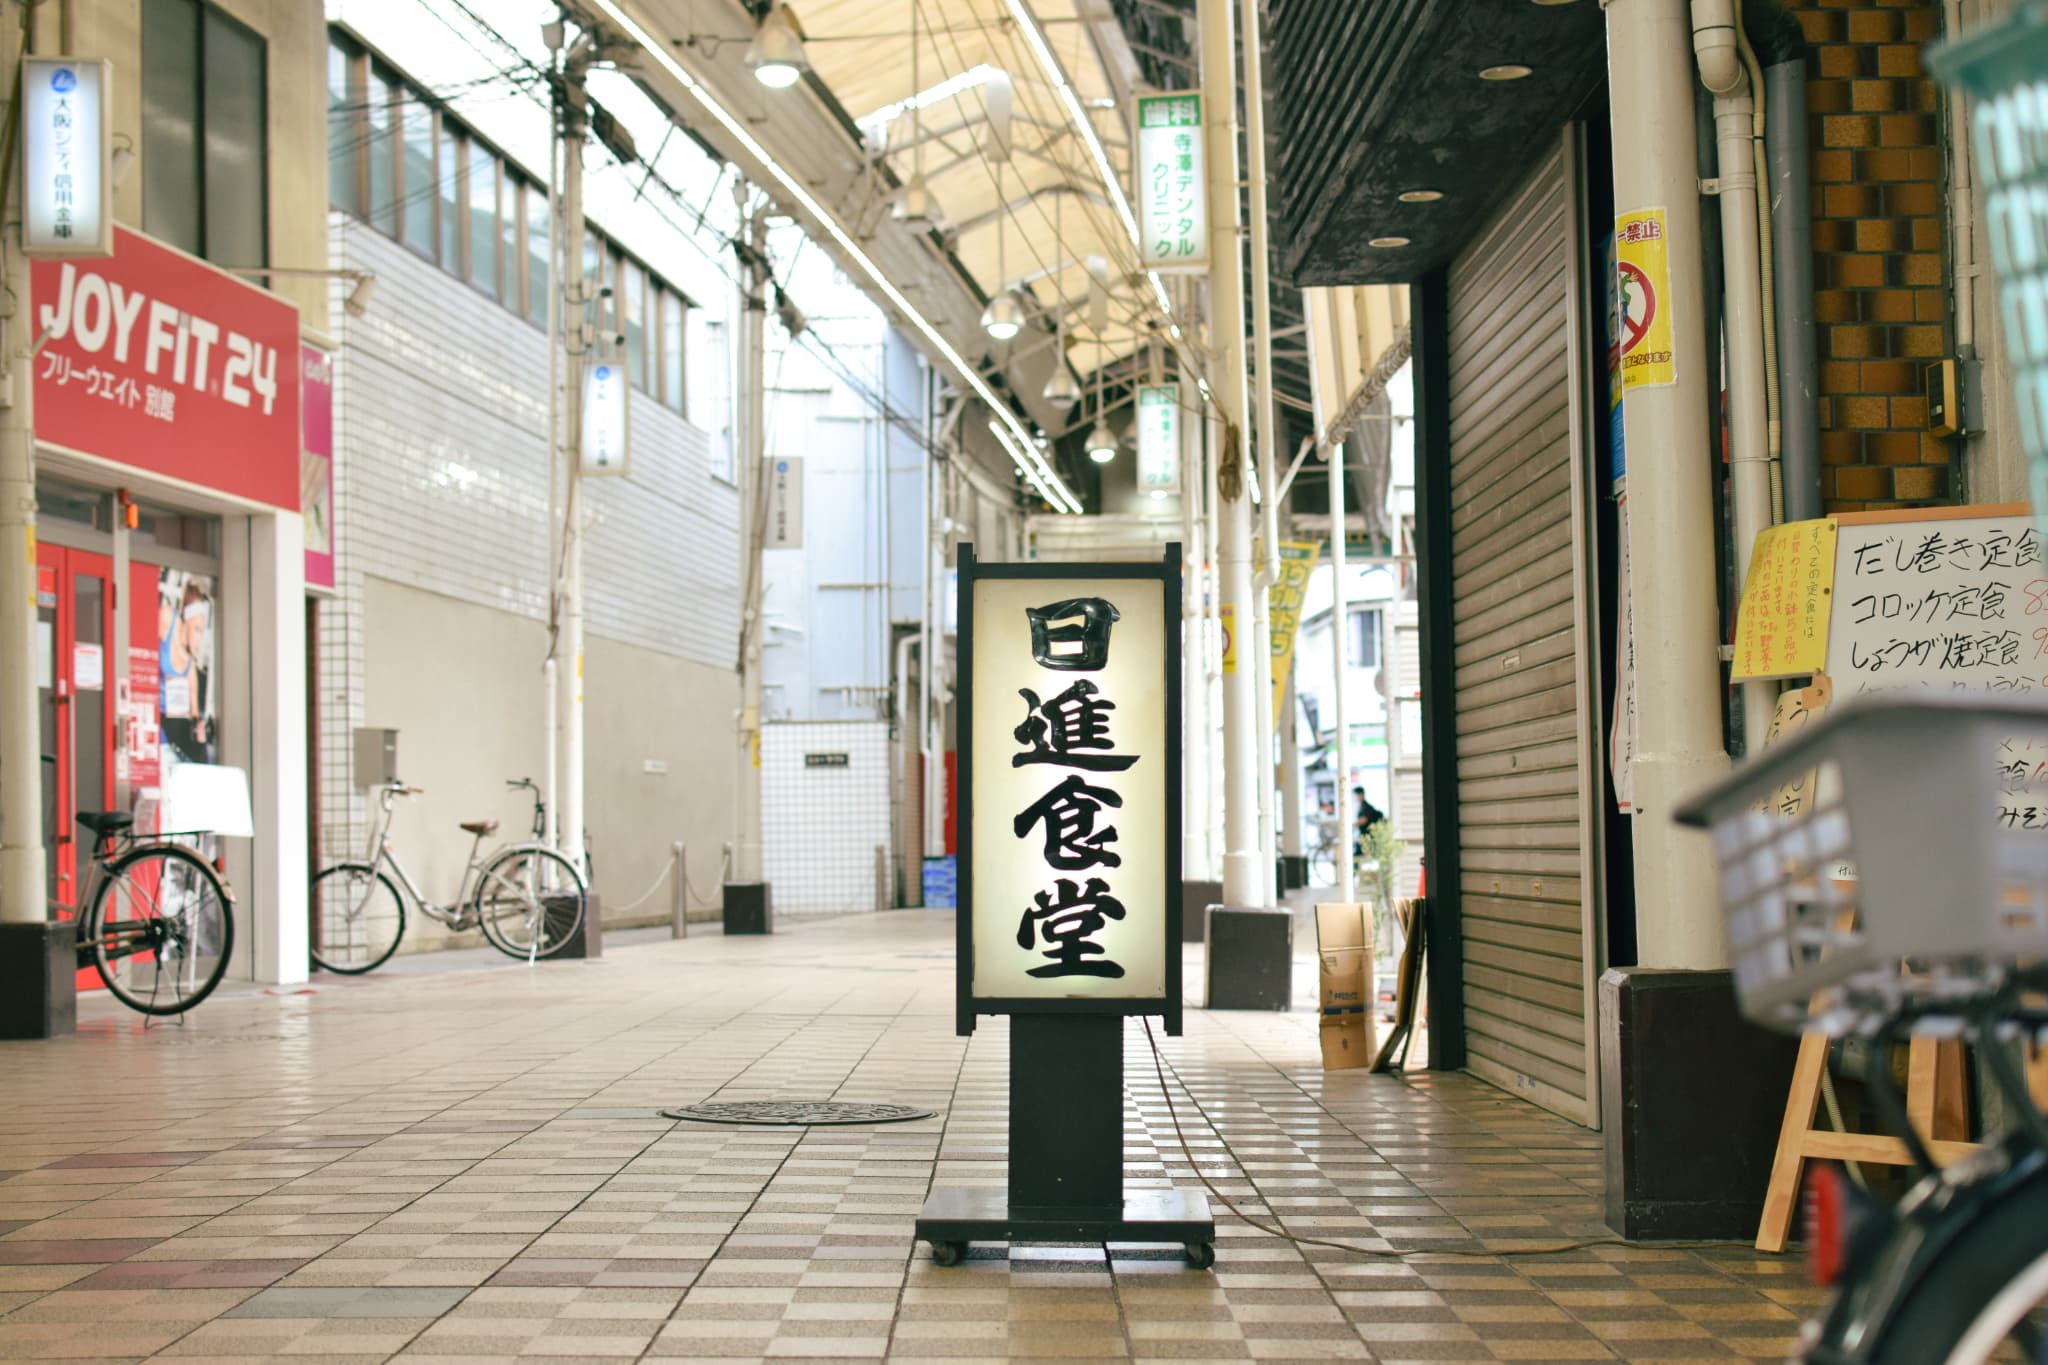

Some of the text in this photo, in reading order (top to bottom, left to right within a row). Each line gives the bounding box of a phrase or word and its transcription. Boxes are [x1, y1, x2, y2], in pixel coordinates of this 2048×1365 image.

[1152, 163, 1172, 258] クリニック
[42, 351, 141, 408] フリーウエイト
[1854, 528, 2043, 575] だし巻き定食
[1851, 582, 2012, 624] コロッケ定食
[2023, 579, 2048, 616] 8
[1852, 629, 2022, 672] しょうが焼定食
[1012, 597, 1141, 979] 日進食堂
